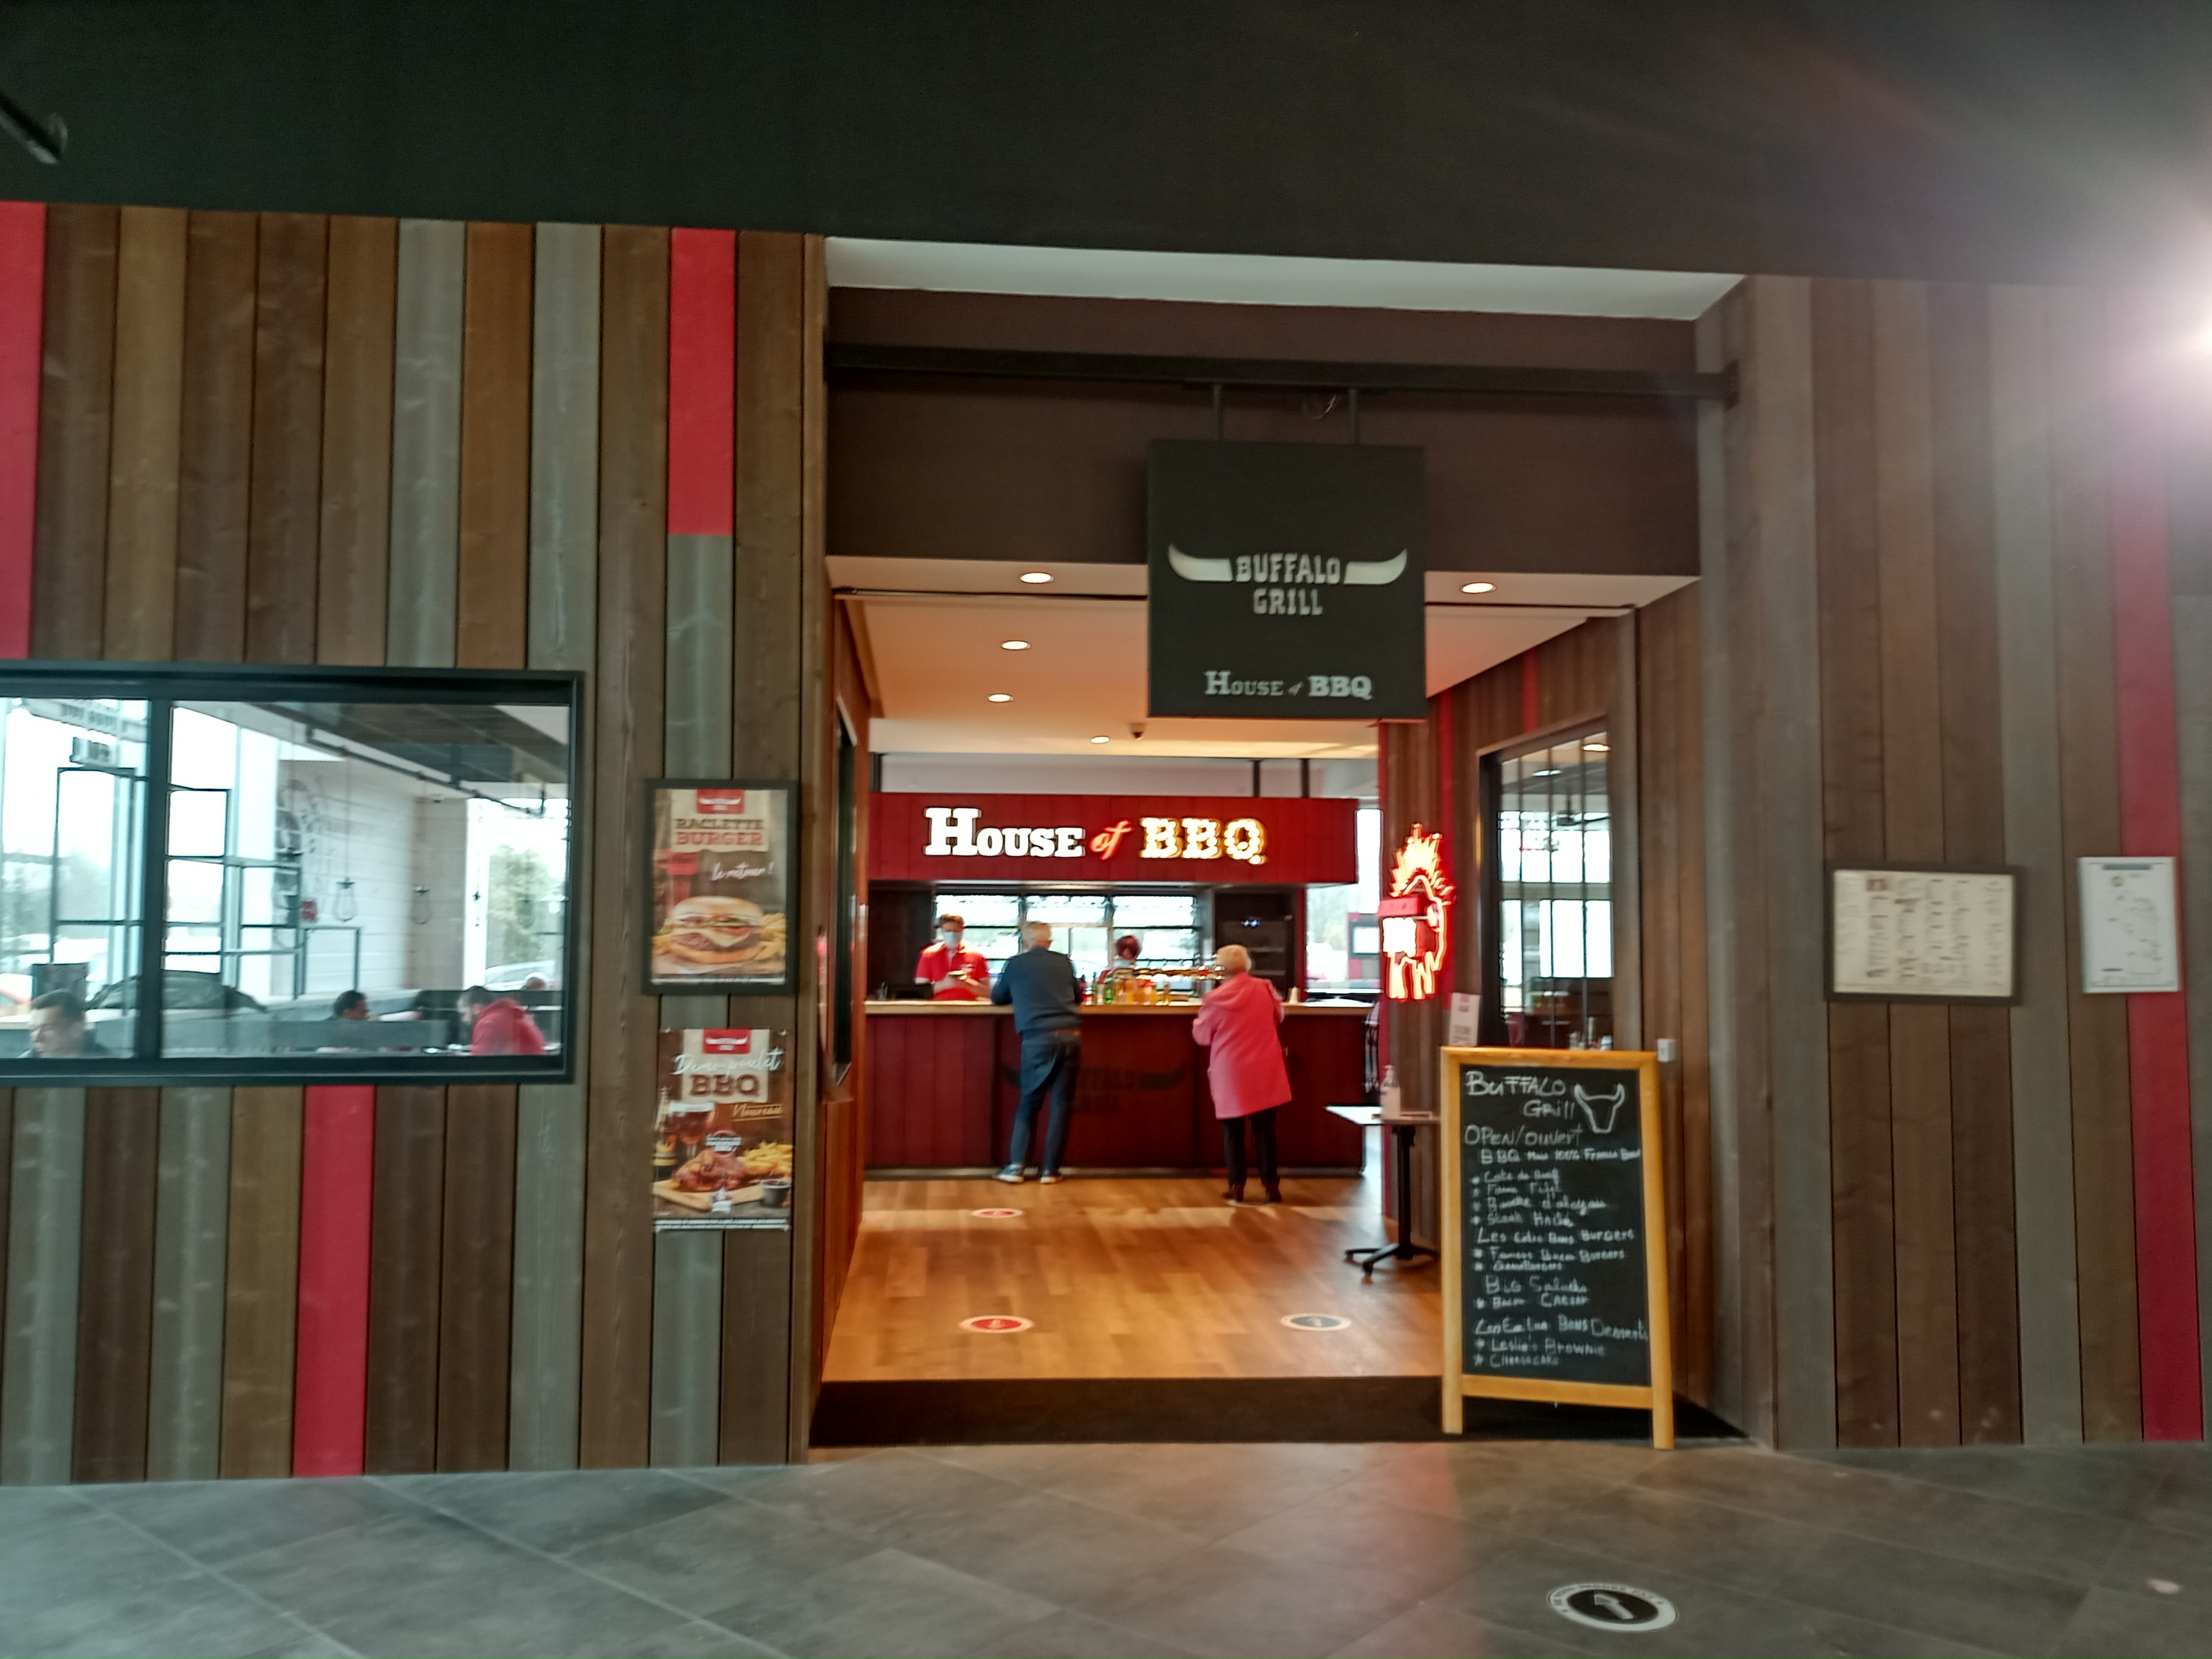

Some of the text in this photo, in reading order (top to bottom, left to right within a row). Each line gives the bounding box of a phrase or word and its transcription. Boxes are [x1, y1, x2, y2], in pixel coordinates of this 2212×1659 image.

[1236, 553, 1341, 585] BUFFALO
[1253, 588, 1323, 616] GRILL
[1308, 675, 1373, 701] BBQ
[674, 818, 764, 830] RACLETTE
[676, 832, 763, 846] BURGER
[1089, 820, 1134, 861] of
[1140, 816, 1268, 865] BBQ
[690, 1073, 760, 1096] BBQ
